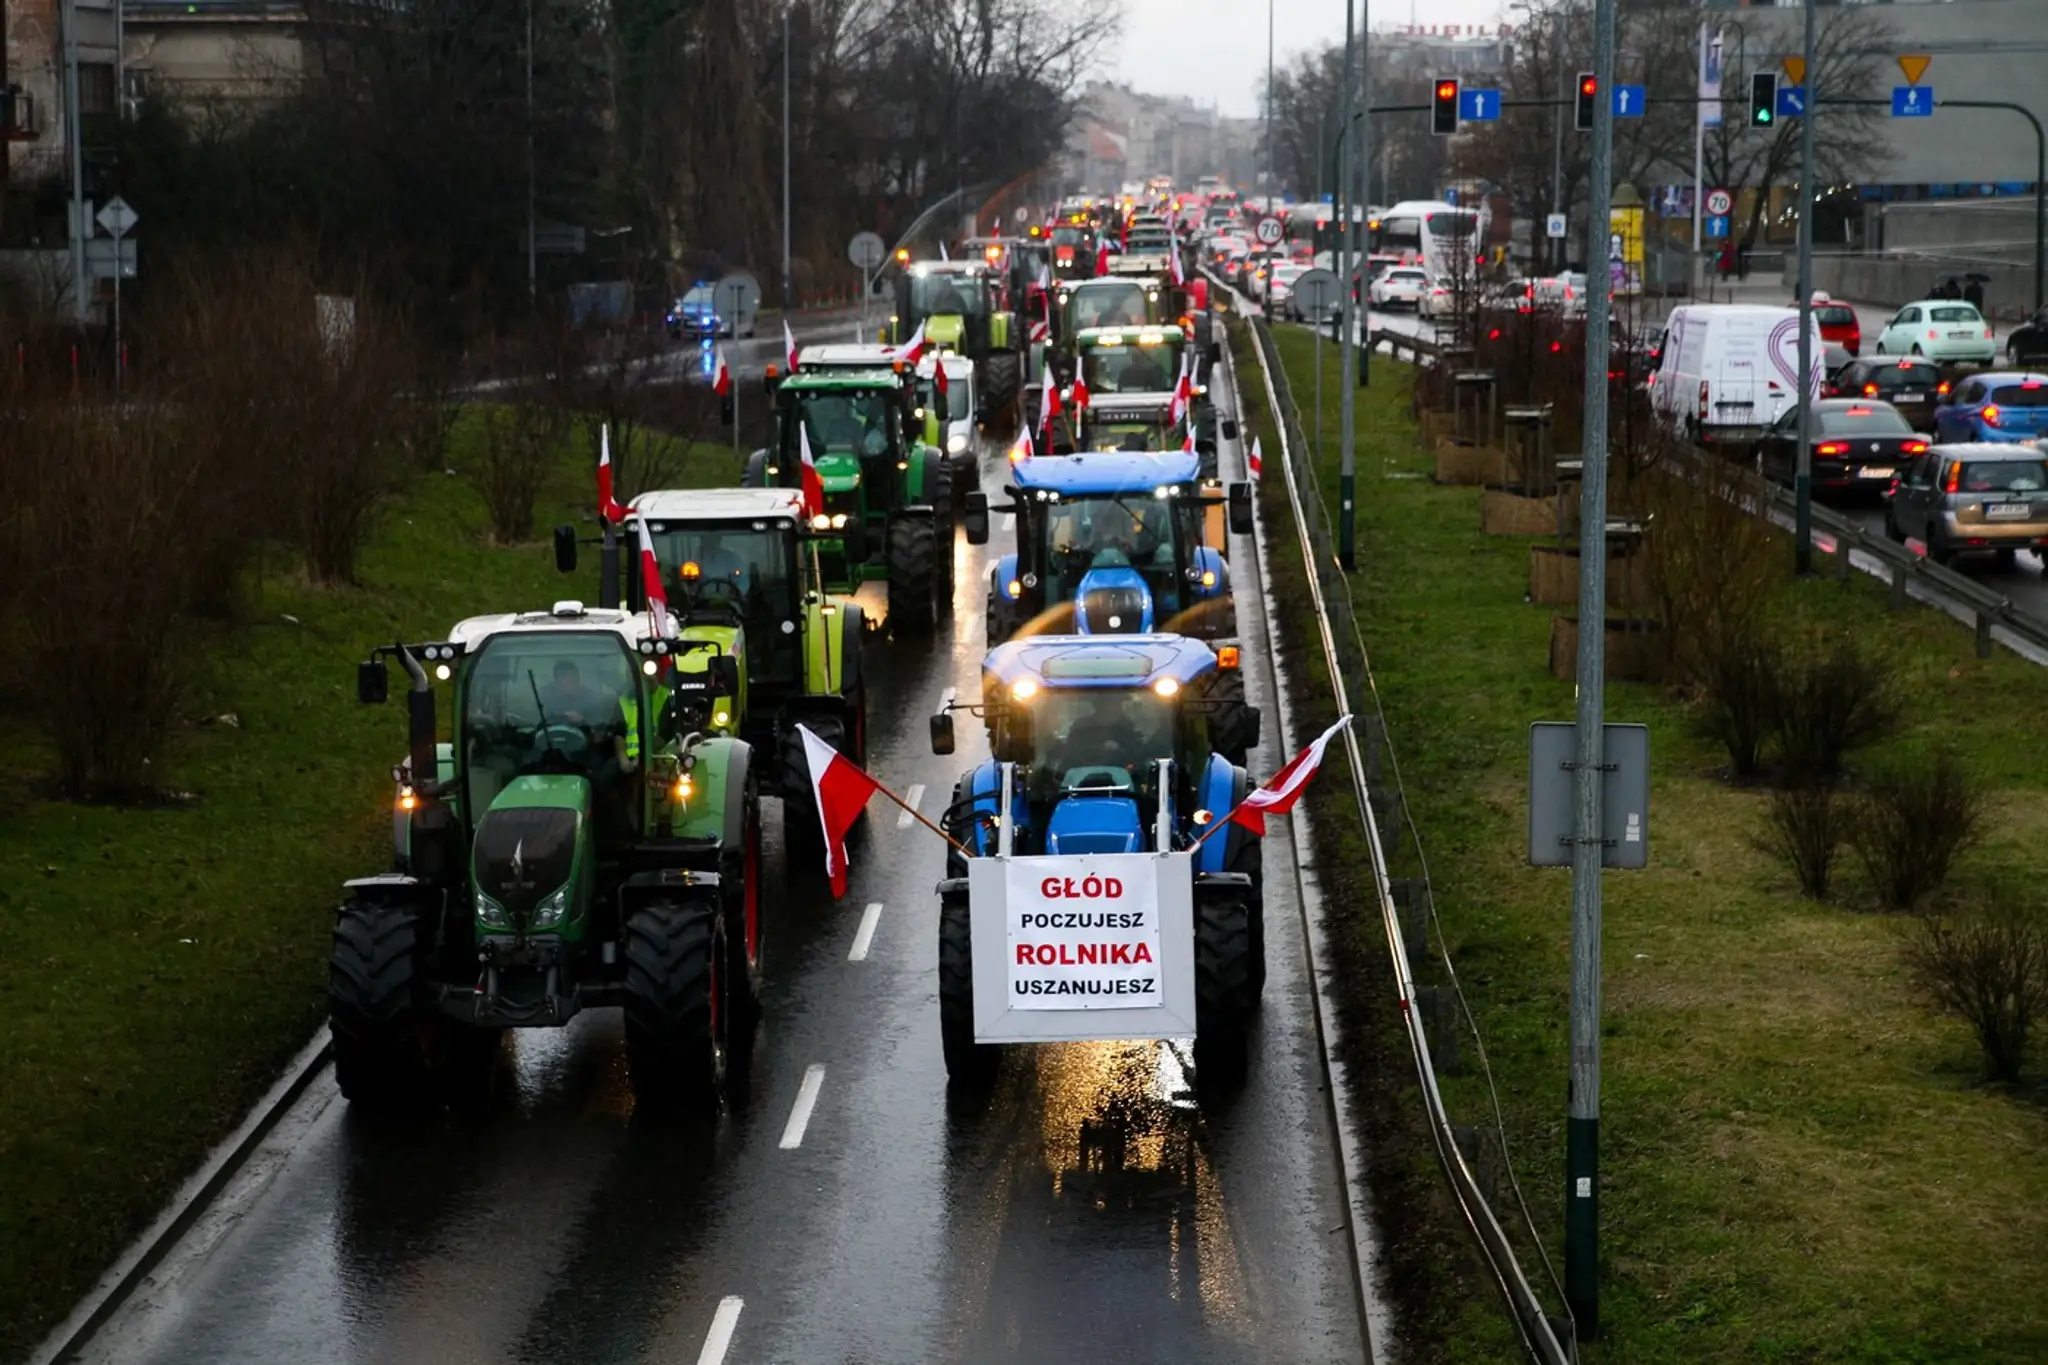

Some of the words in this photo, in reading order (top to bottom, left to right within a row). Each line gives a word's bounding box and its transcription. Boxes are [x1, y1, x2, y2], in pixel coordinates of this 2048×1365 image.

[1396, 24, 1514, 37] JUBILA
[1711, 196, 1729, 210] 70
[1261, 223, 1281, 238] 70
[1041, 872, 1123, 898] GŁÓD
[1021, 912, 1144, 928] POCZUJESZ
[1016, 942, 1152, 965] ROLNIKA
[1015, 979, 1155, 995] USZANUJESZ
